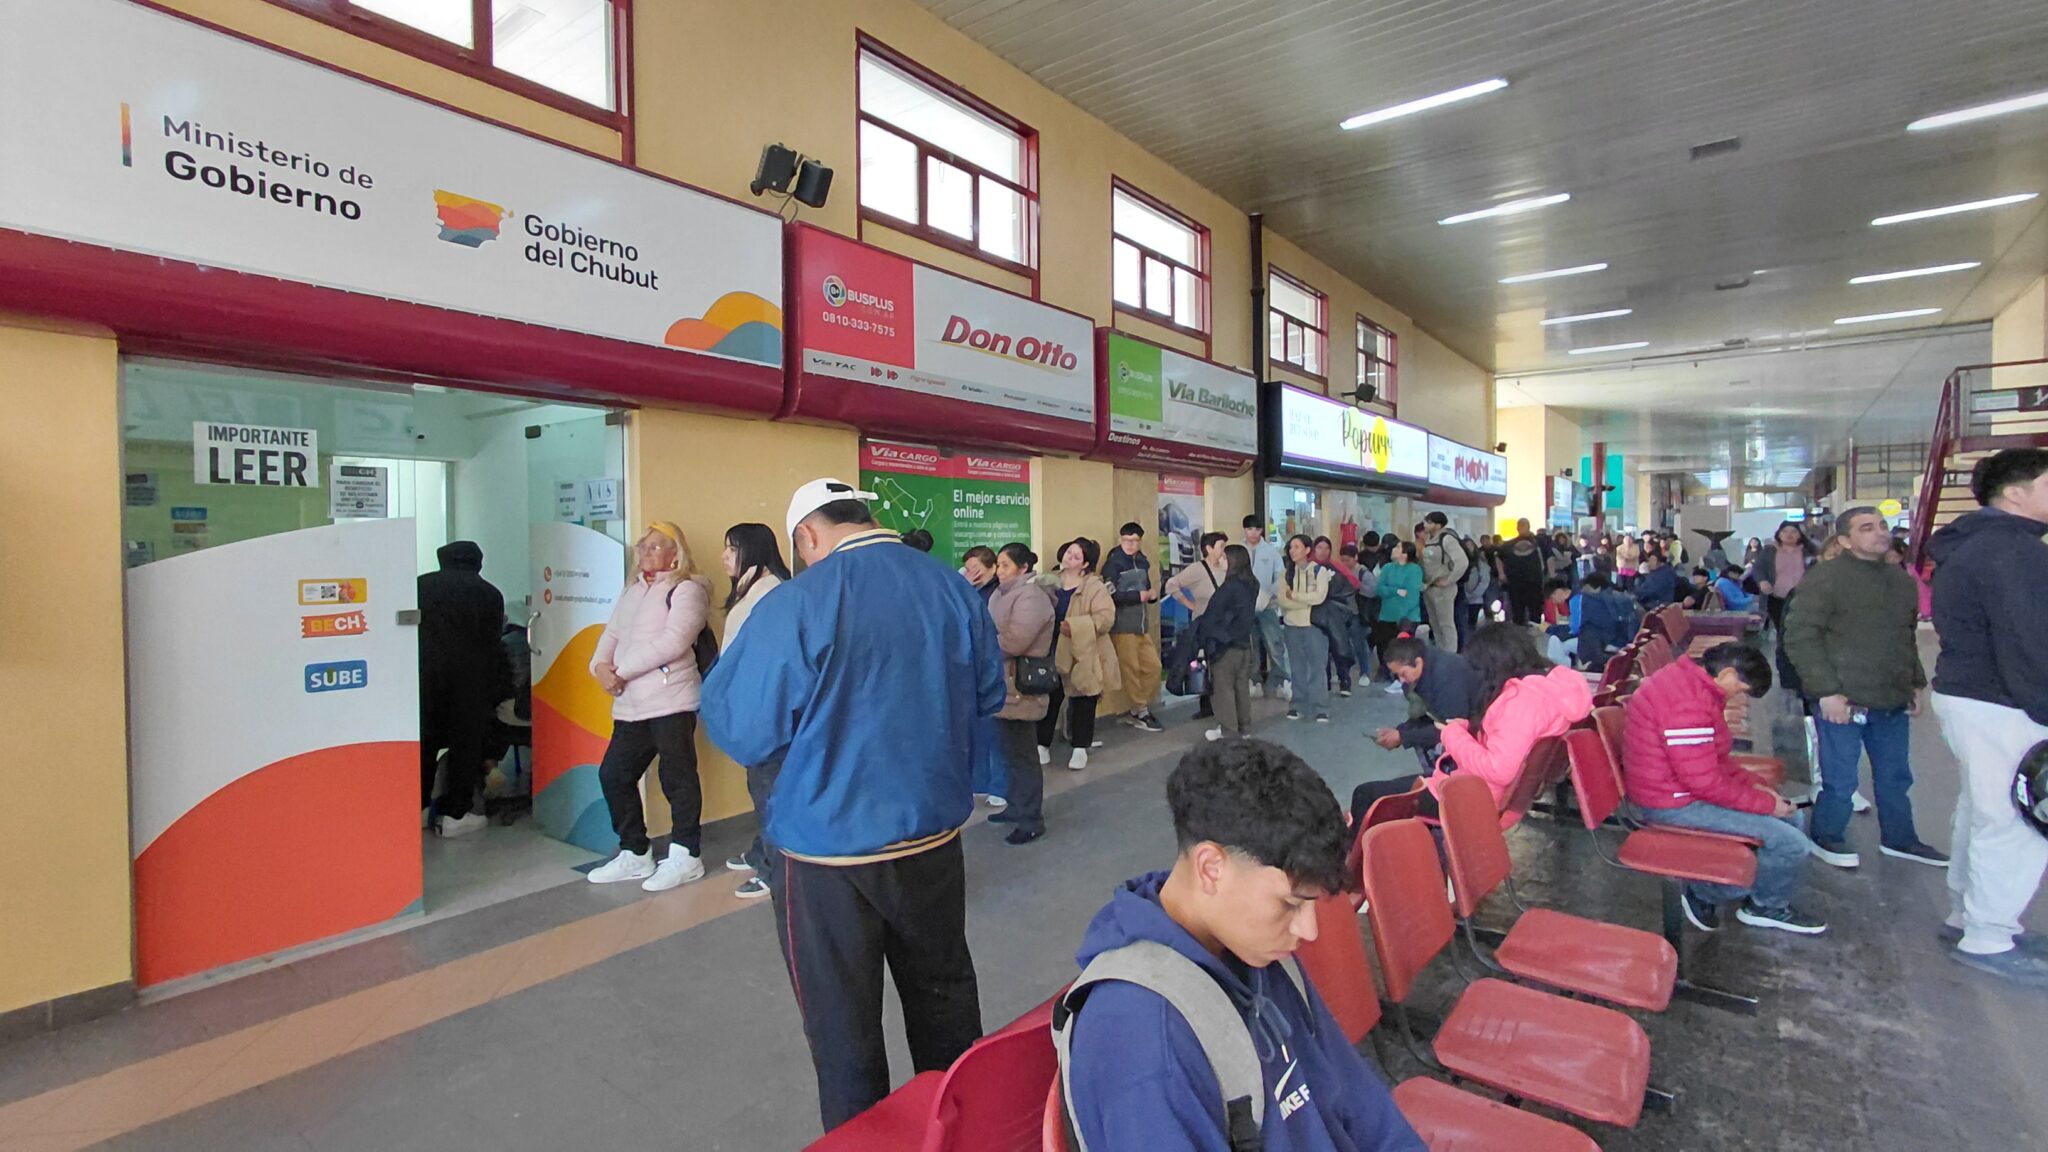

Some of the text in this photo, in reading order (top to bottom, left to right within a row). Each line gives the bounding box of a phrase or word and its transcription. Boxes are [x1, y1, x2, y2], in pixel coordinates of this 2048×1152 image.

[164, 114, 374, 190] Ministerio de
[165, 150, 363, 221] Gobierno
[525, 214, 639, 262] Gobierno
[525, 242, 660, 291] del Chubut
[847, 288, 895, 312] BUSPLUS
[822, 311, 895, 337] 0810-333-7575
[941, 314, 1077, 371] Don Otto
[835, 362, 856, 371] TAC
[1167, 378, 1194, 401] Via
[1197, 387, 1256, 418] Bariloche
[208, 425, 310, 447] IMPORTANTE
[209, 447, 308, 487] LEER
[870, 446, 938, 464] Via CARGO
[967, 457, 1022, 471] Via CARGO
[953, 489, 1030, 506] El mejor servicio
[953, 505, 985, 519] online
[310, 615, 361, 633] BECH
[310, 669, 362, 688] SUBE
